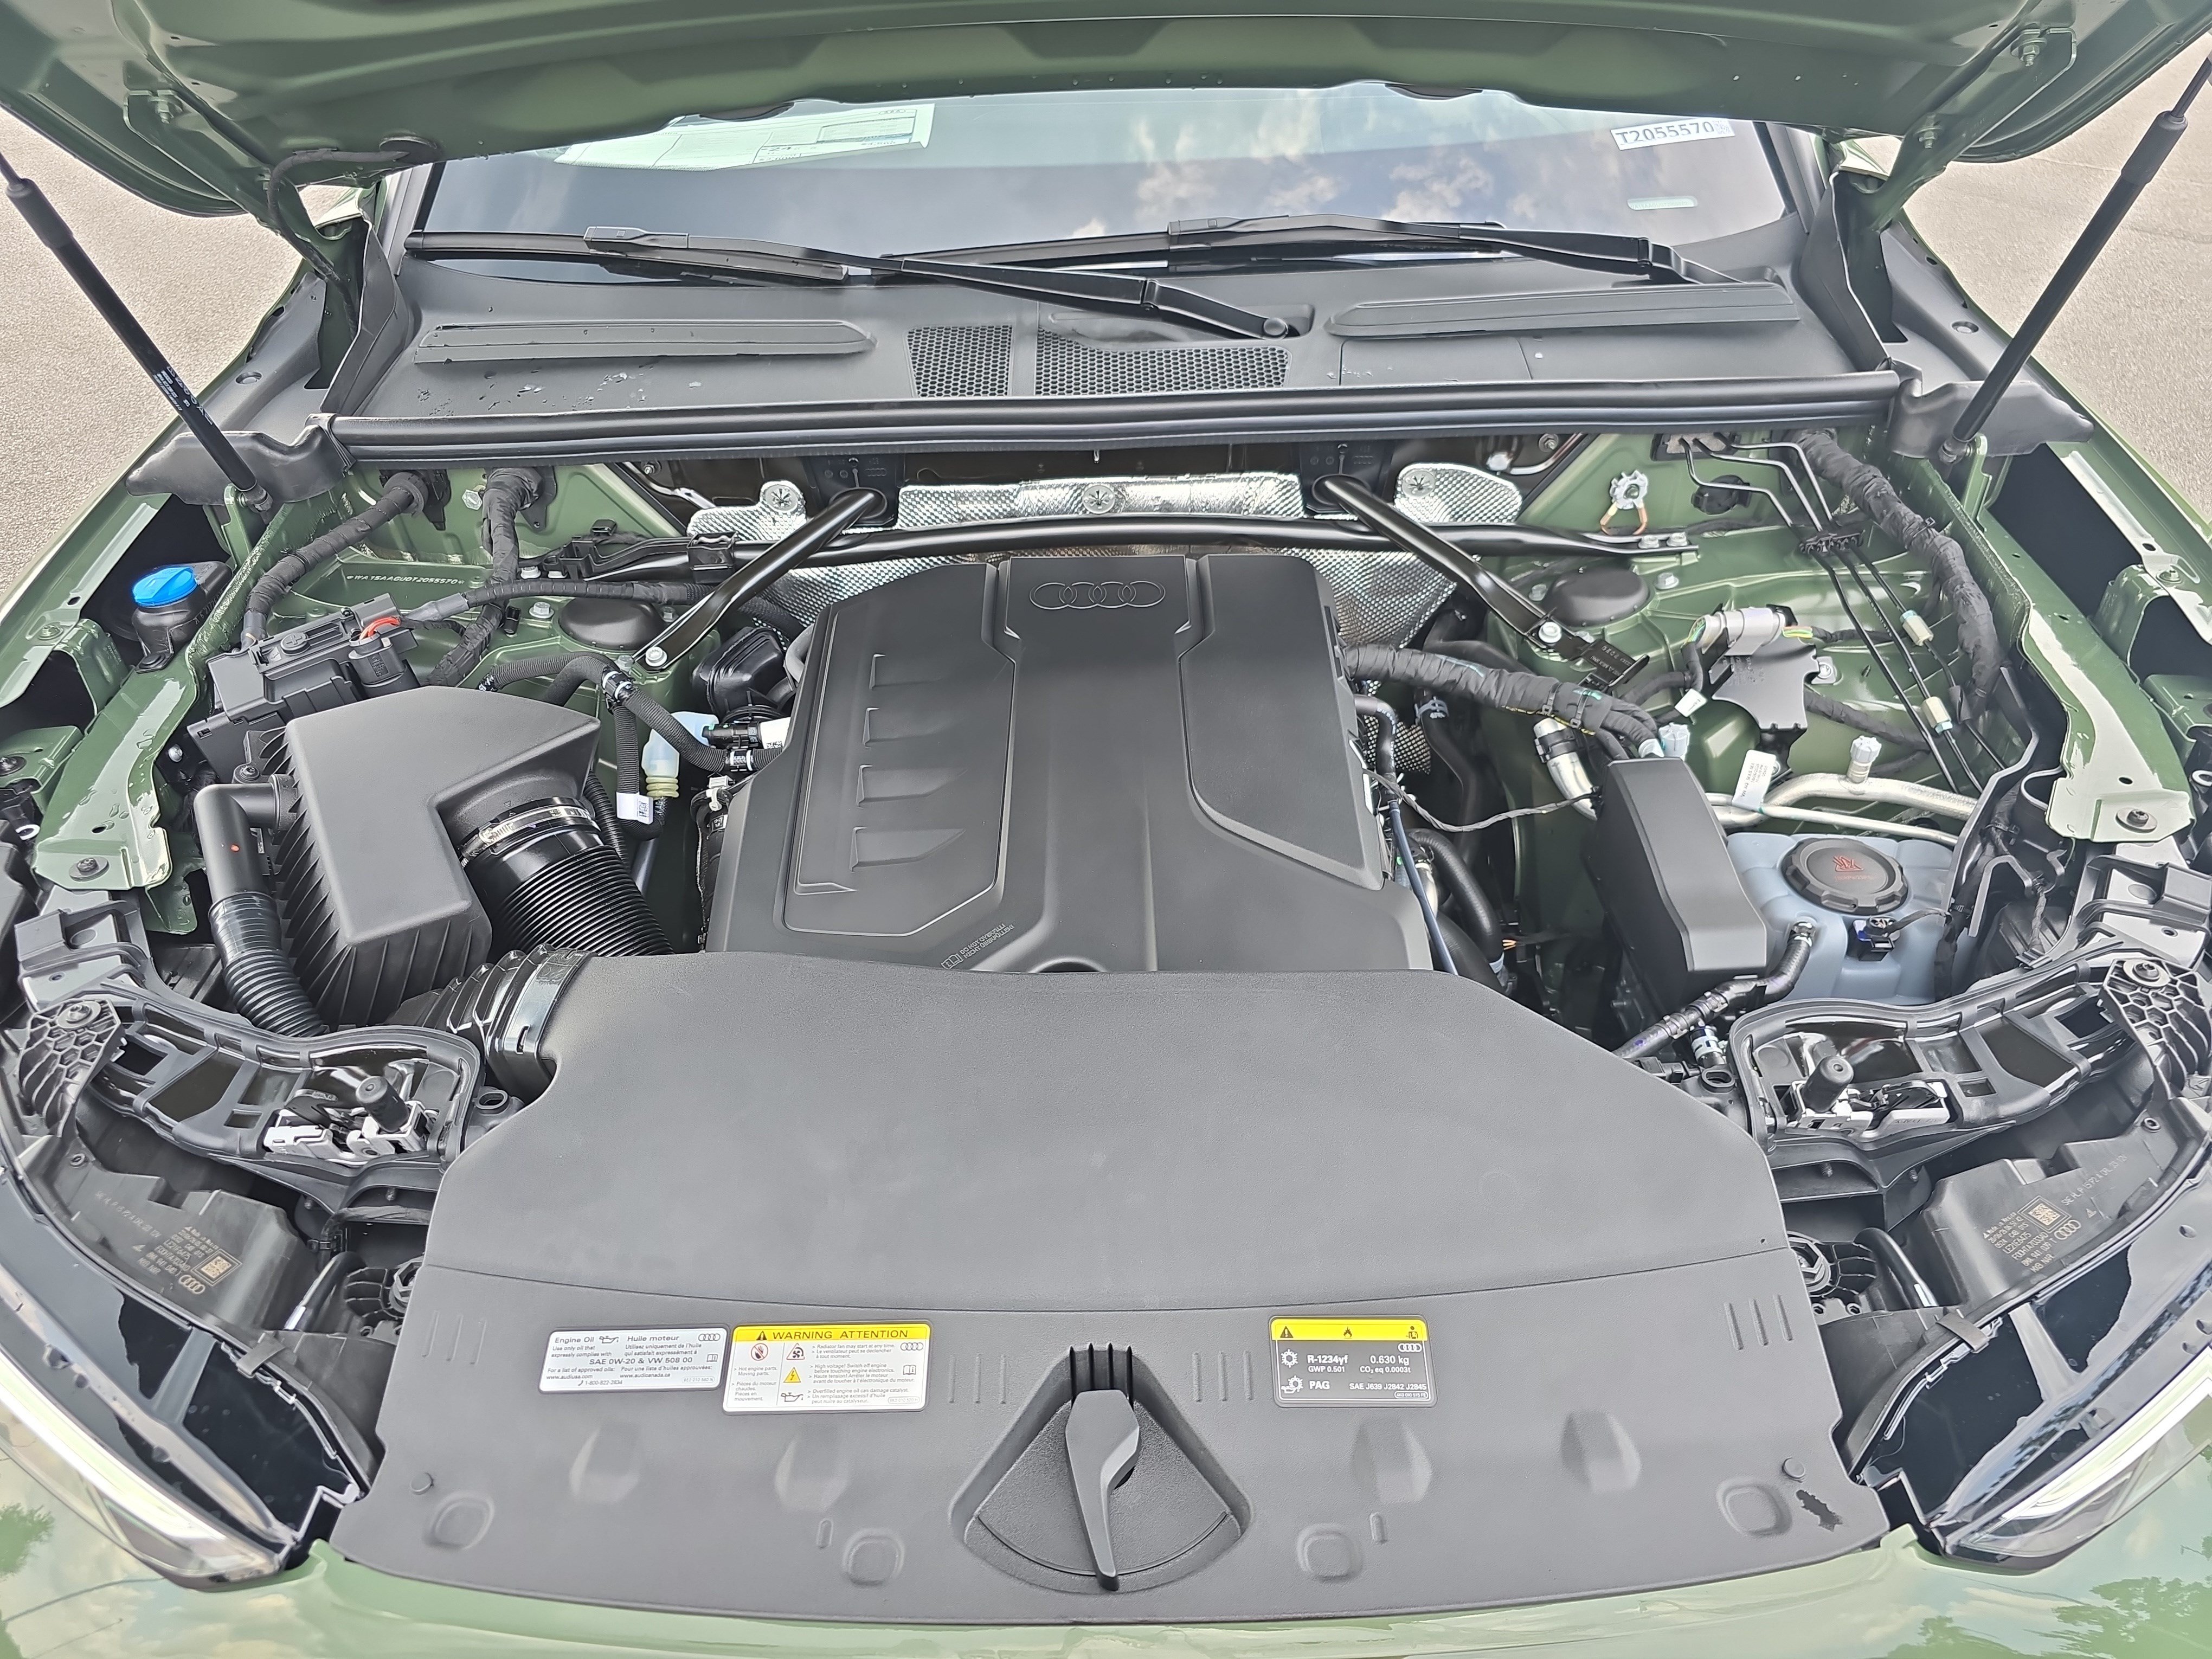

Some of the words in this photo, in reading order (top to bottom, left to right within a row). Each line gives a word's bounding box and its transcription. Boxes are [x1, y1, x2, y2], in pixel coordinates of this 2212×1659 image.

[1615, 121, 1714, 145] T2055570
[960, 947, 969, 955] DO
[968, 939, 981, 949] NOT
[963, 946, 981, 959] NICHT
[773, 1332, 833, 1340] WARNING
[840, 1330, 909, 1339] ATTENTION
[1307, 1355, 1349, 1366] R-1234yf
[1369, 1355, 1396, 1365] 0.630
[1398, 1355, 1409, 1366] kg
[1309, 1381, 1330, 1390] PAG
